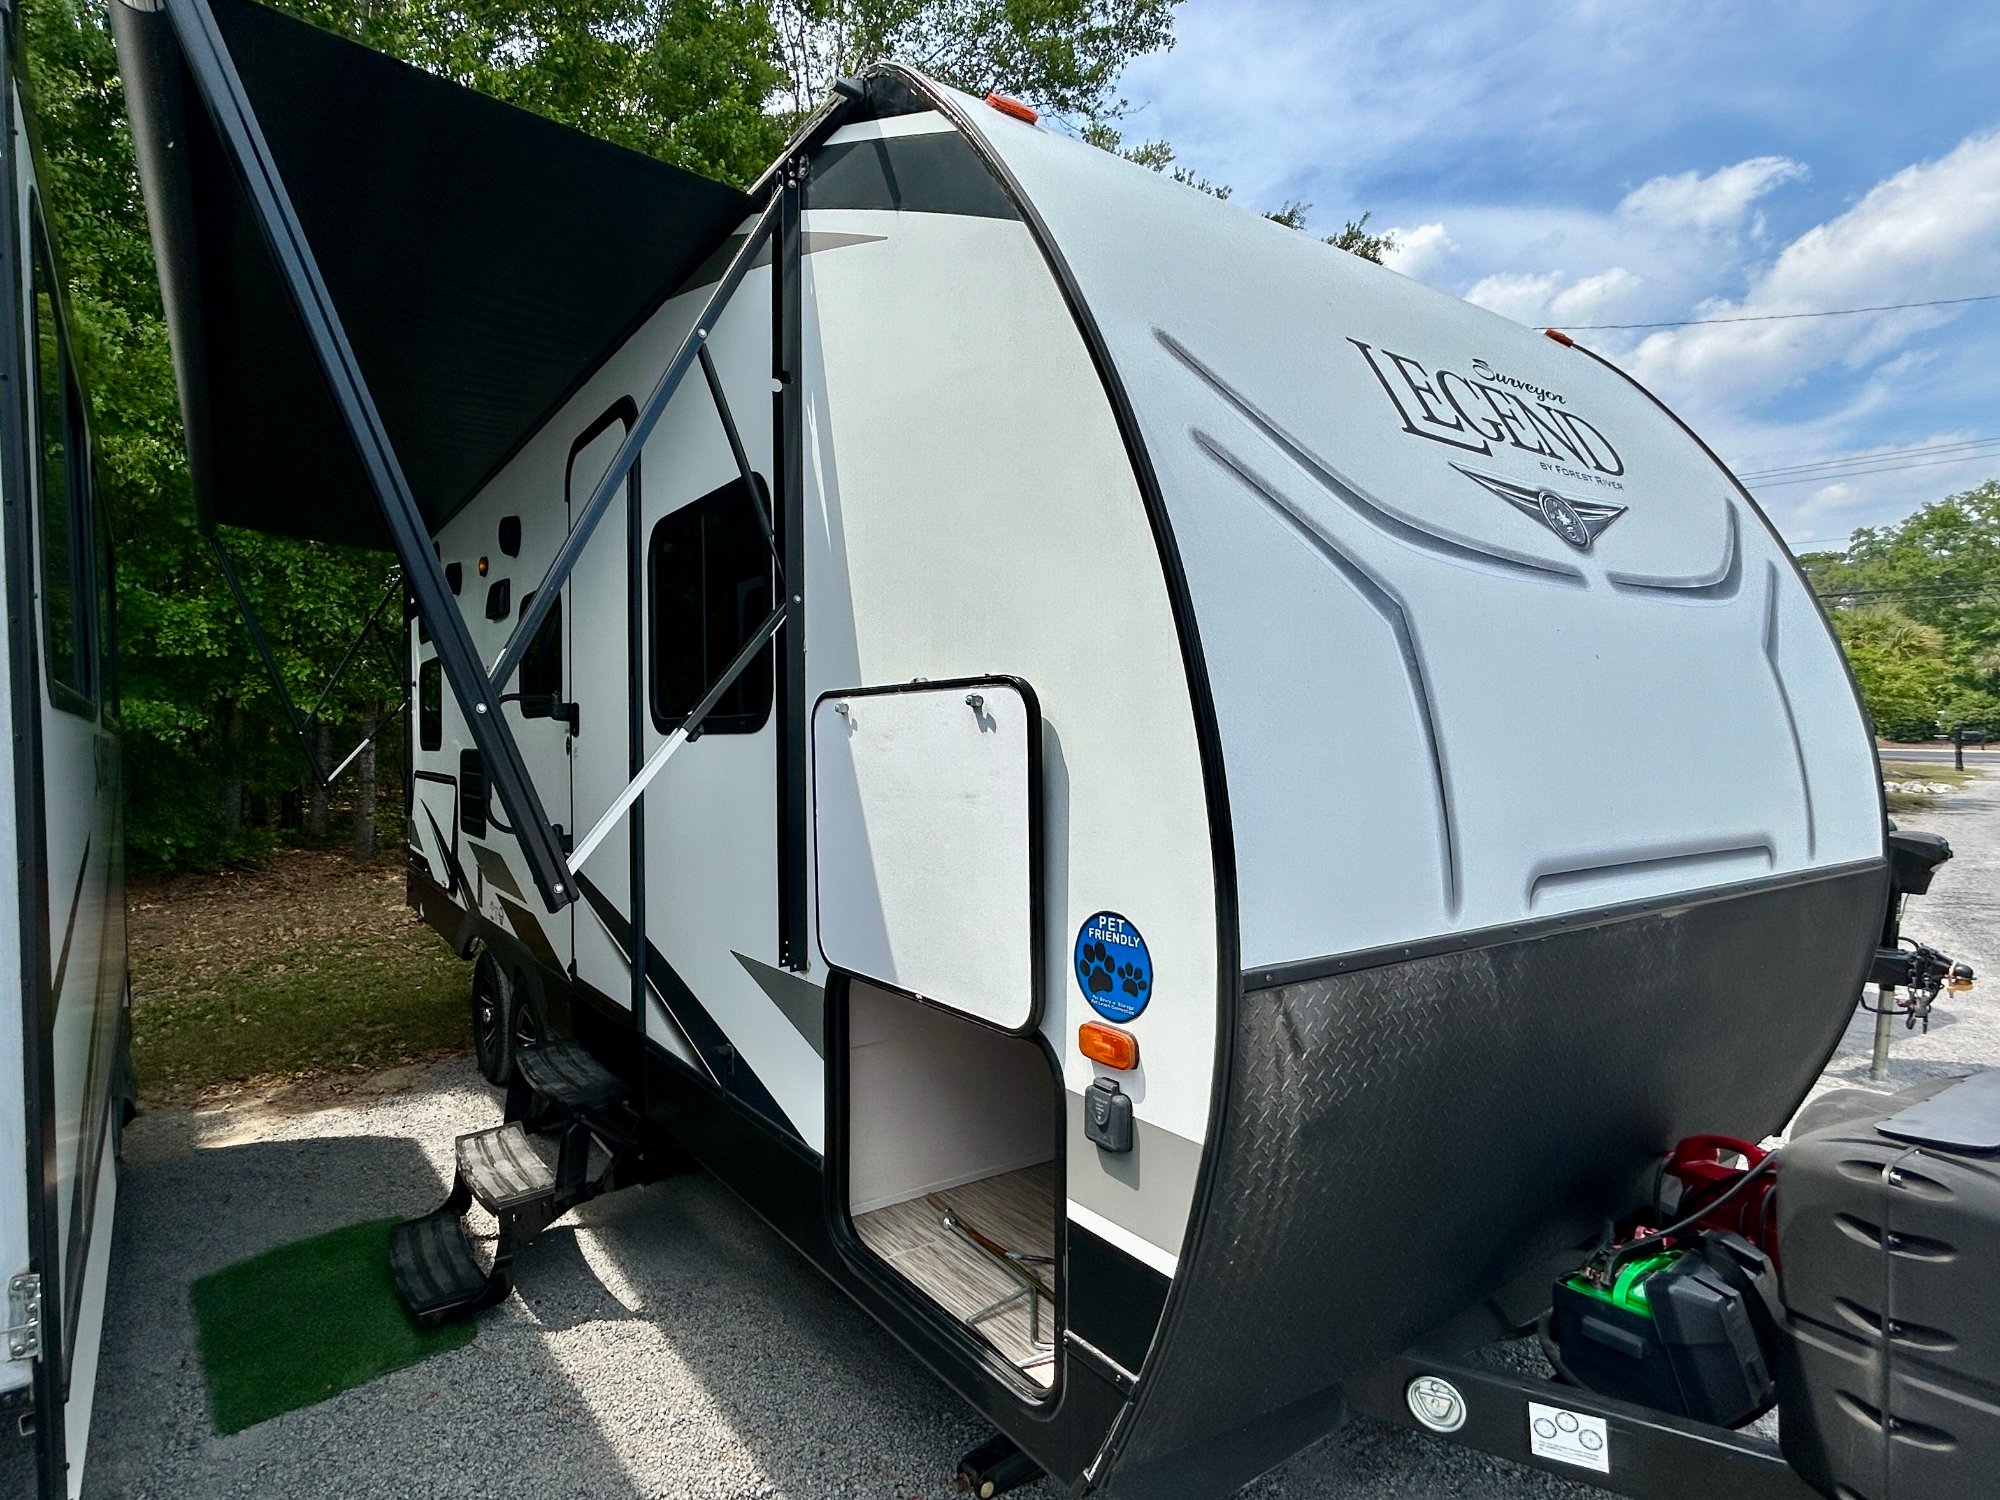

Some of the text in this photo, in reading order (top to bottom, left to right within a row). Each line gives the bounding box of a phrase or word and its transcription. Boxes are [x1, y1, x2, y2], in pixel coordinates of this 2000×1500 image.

[1472, 358, 1566, 404] Surveyor
[1346, 336, 1625, 477] LEGEND
[1540, 461, 1552, 471] BY
[1099, 915, 1125, 933] PET
[1088, 927, 1140, 948] FRIENDLY
